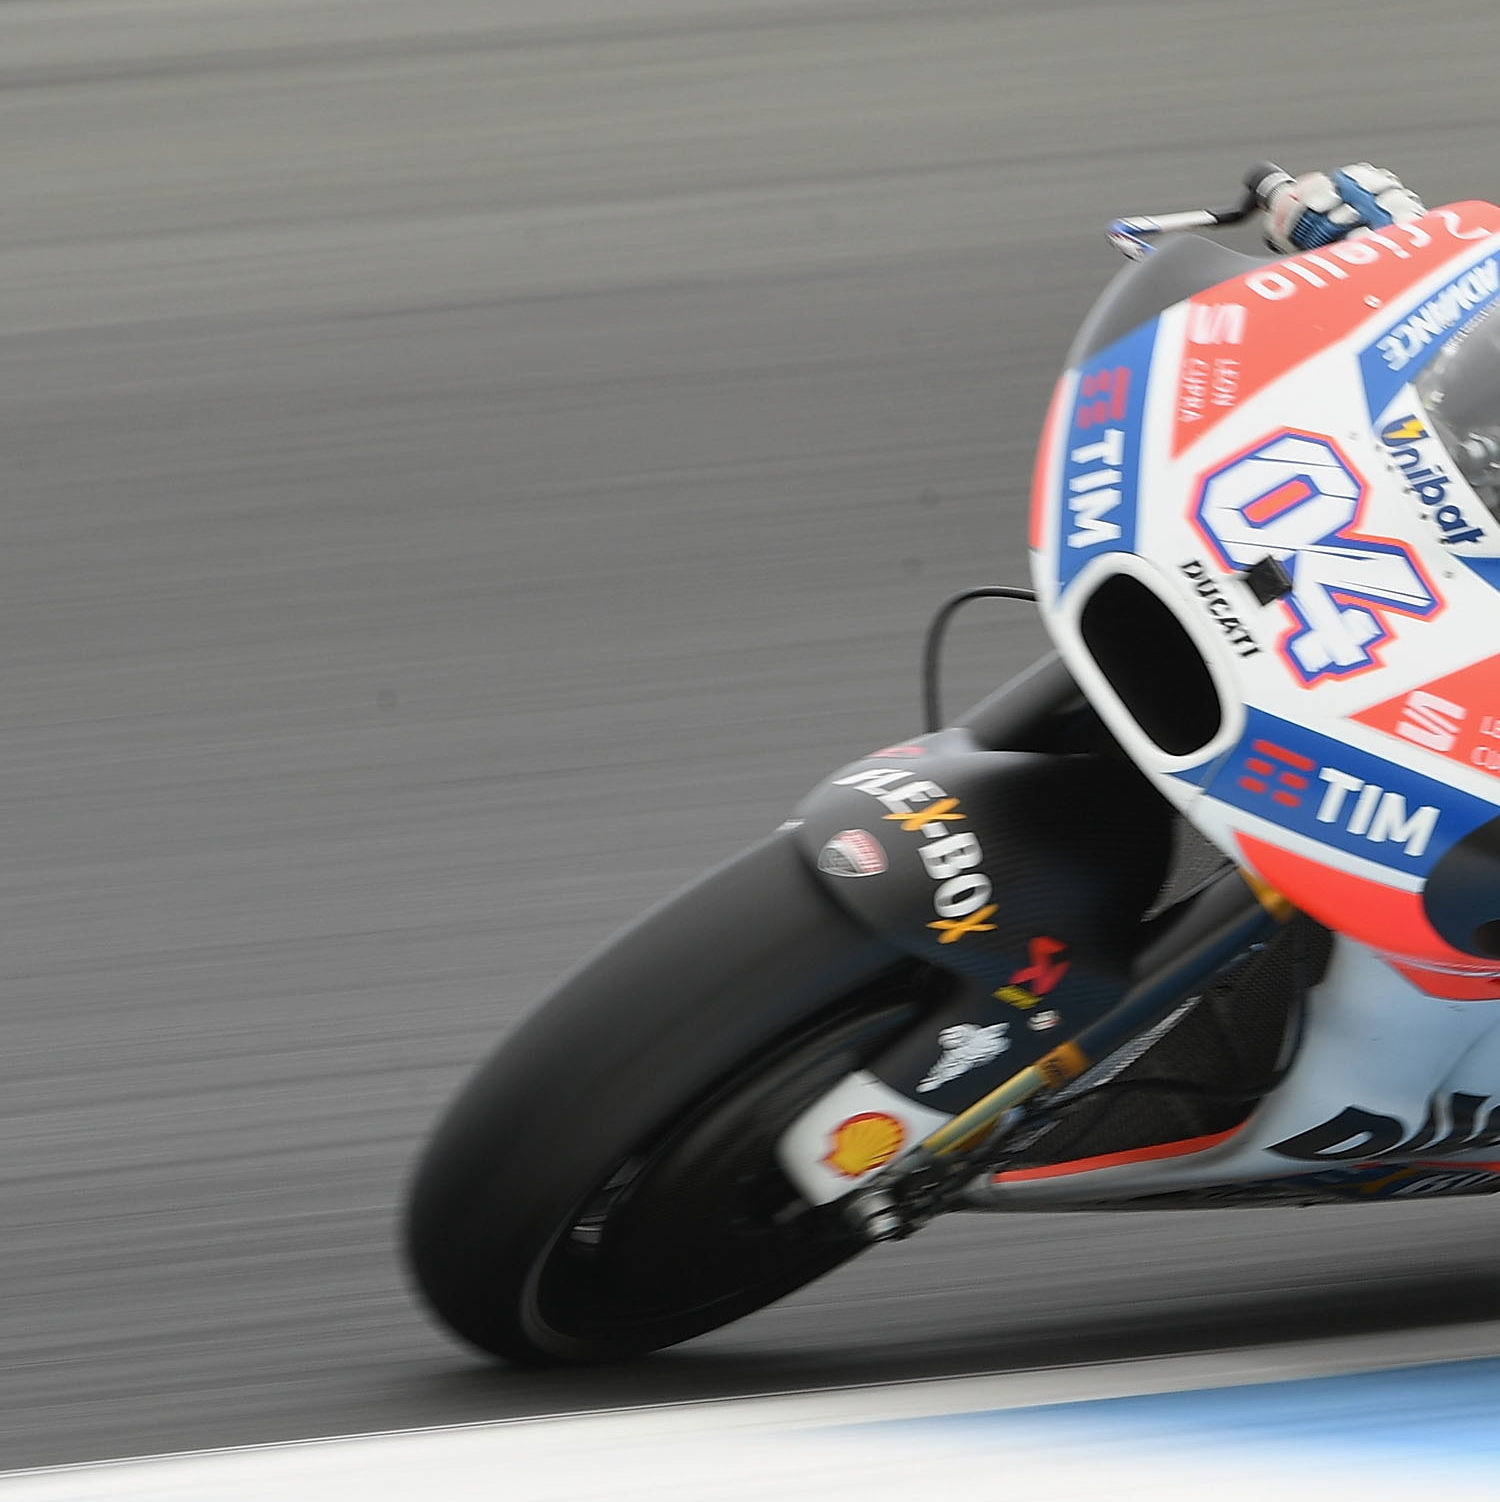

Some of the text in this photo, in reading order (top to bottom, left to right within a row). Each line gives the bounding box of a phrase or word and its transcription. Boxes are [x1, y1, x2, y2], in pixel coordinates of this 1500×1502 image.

[1067, 428, 1125, 549] TIM
[1381, 414, 1485, 544] Unibat
[1181, 560, 1262, 658] DUCATI
[1185, 426, 1447, 691] 04
[1316, 766, 1441, 857] TIM
